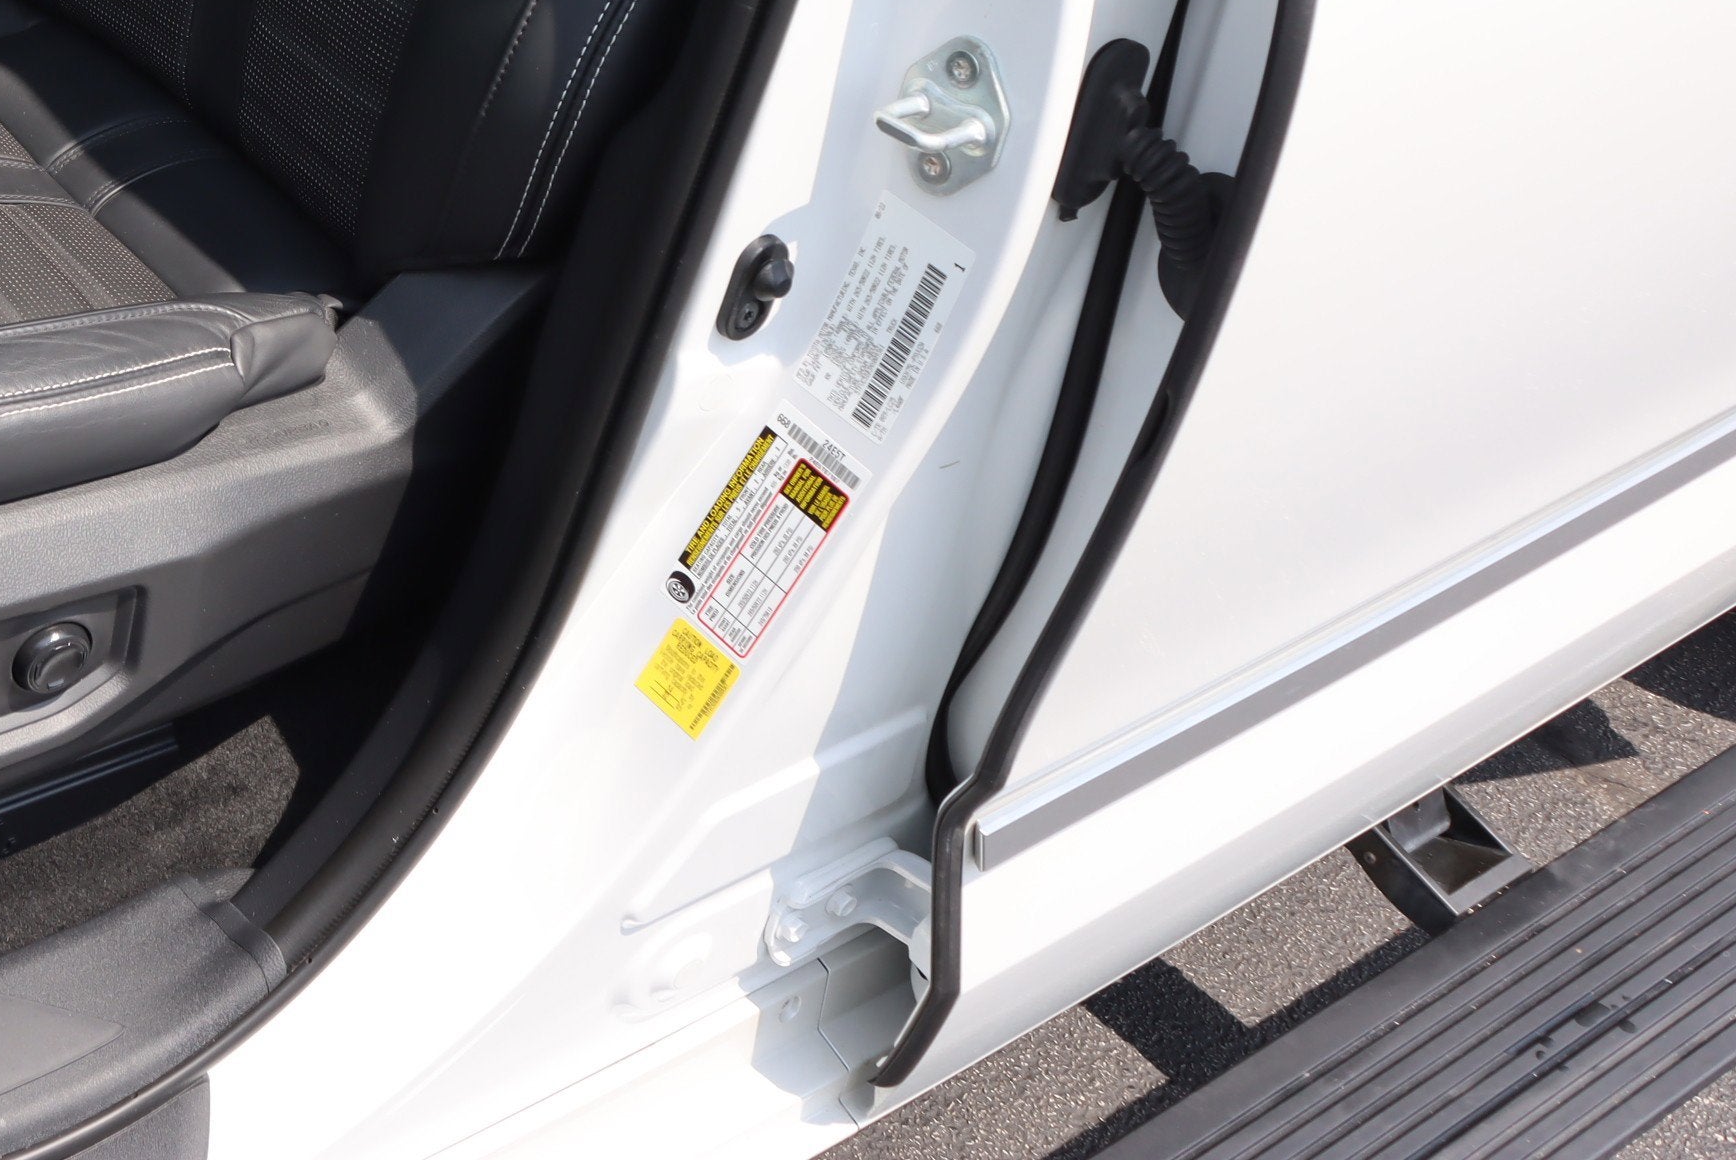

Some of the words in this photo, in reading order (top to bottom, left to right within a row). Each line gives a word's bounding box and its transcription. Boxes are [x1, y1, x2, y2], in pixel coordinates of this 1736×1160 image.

[953, 260, 965, 272] 1
[777, 414, 791, 428] 668
[749, 435, 774, 471] CHARGEMENT
[822, 440, 846, 461] 24E5T
[685, 536, 699, 553] TIRE
[697, 520, 709, 537] AND
[706, 486, 731, 521] LOADING
[728, 435, 764, 489] INFORMATION
